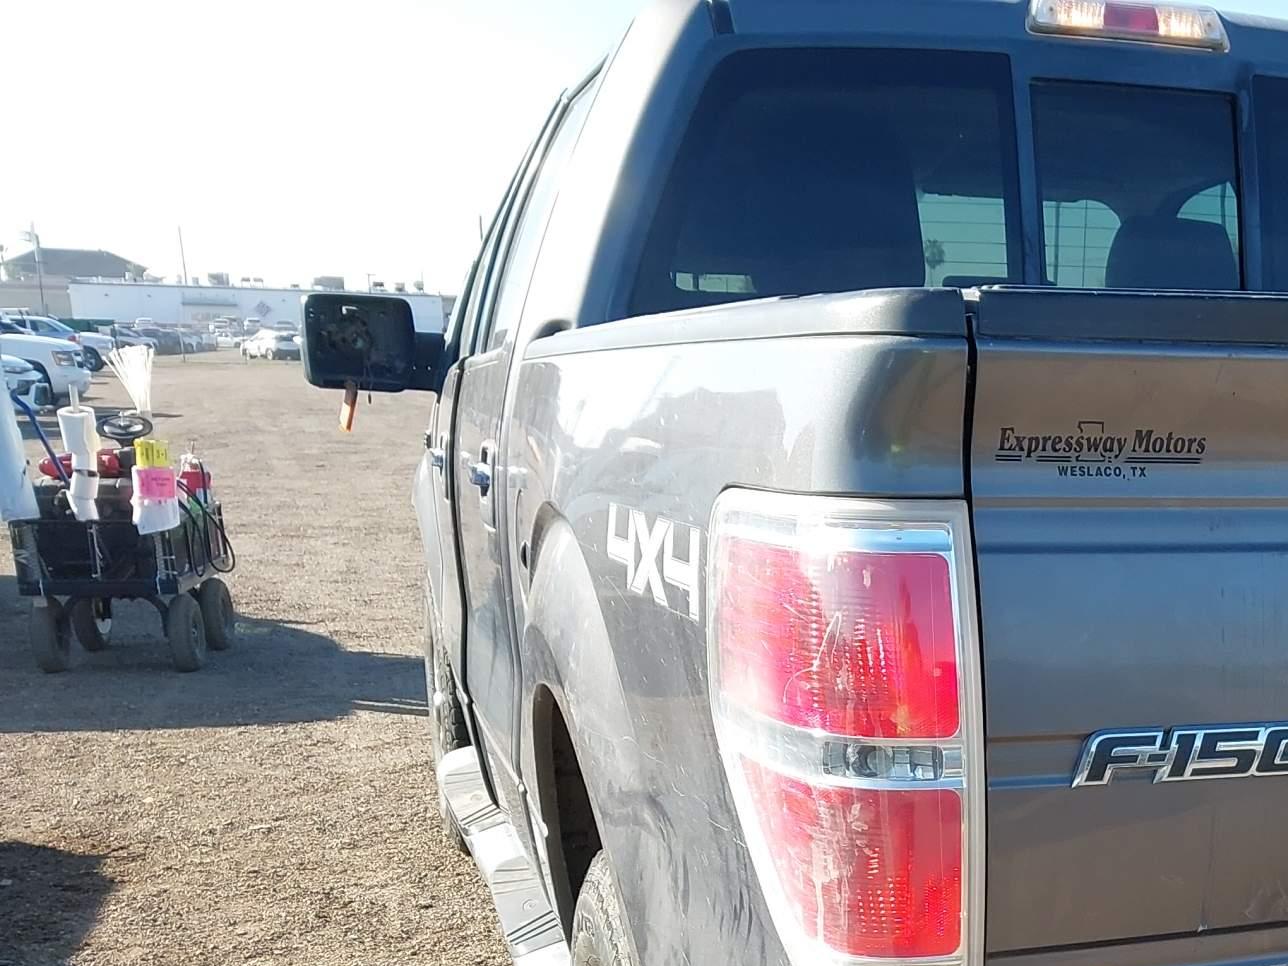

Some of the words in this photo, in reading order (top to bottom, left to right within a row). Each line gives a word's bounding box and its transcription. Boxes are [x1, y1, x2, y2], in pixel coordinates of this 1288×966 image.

[998, 427, 1127, 458] Expressway
[1131, 429, 1206, 454] Motors
[1057, 465, 1127, 479] WESLACO,
[1130, 466, 1147, 477] TX
